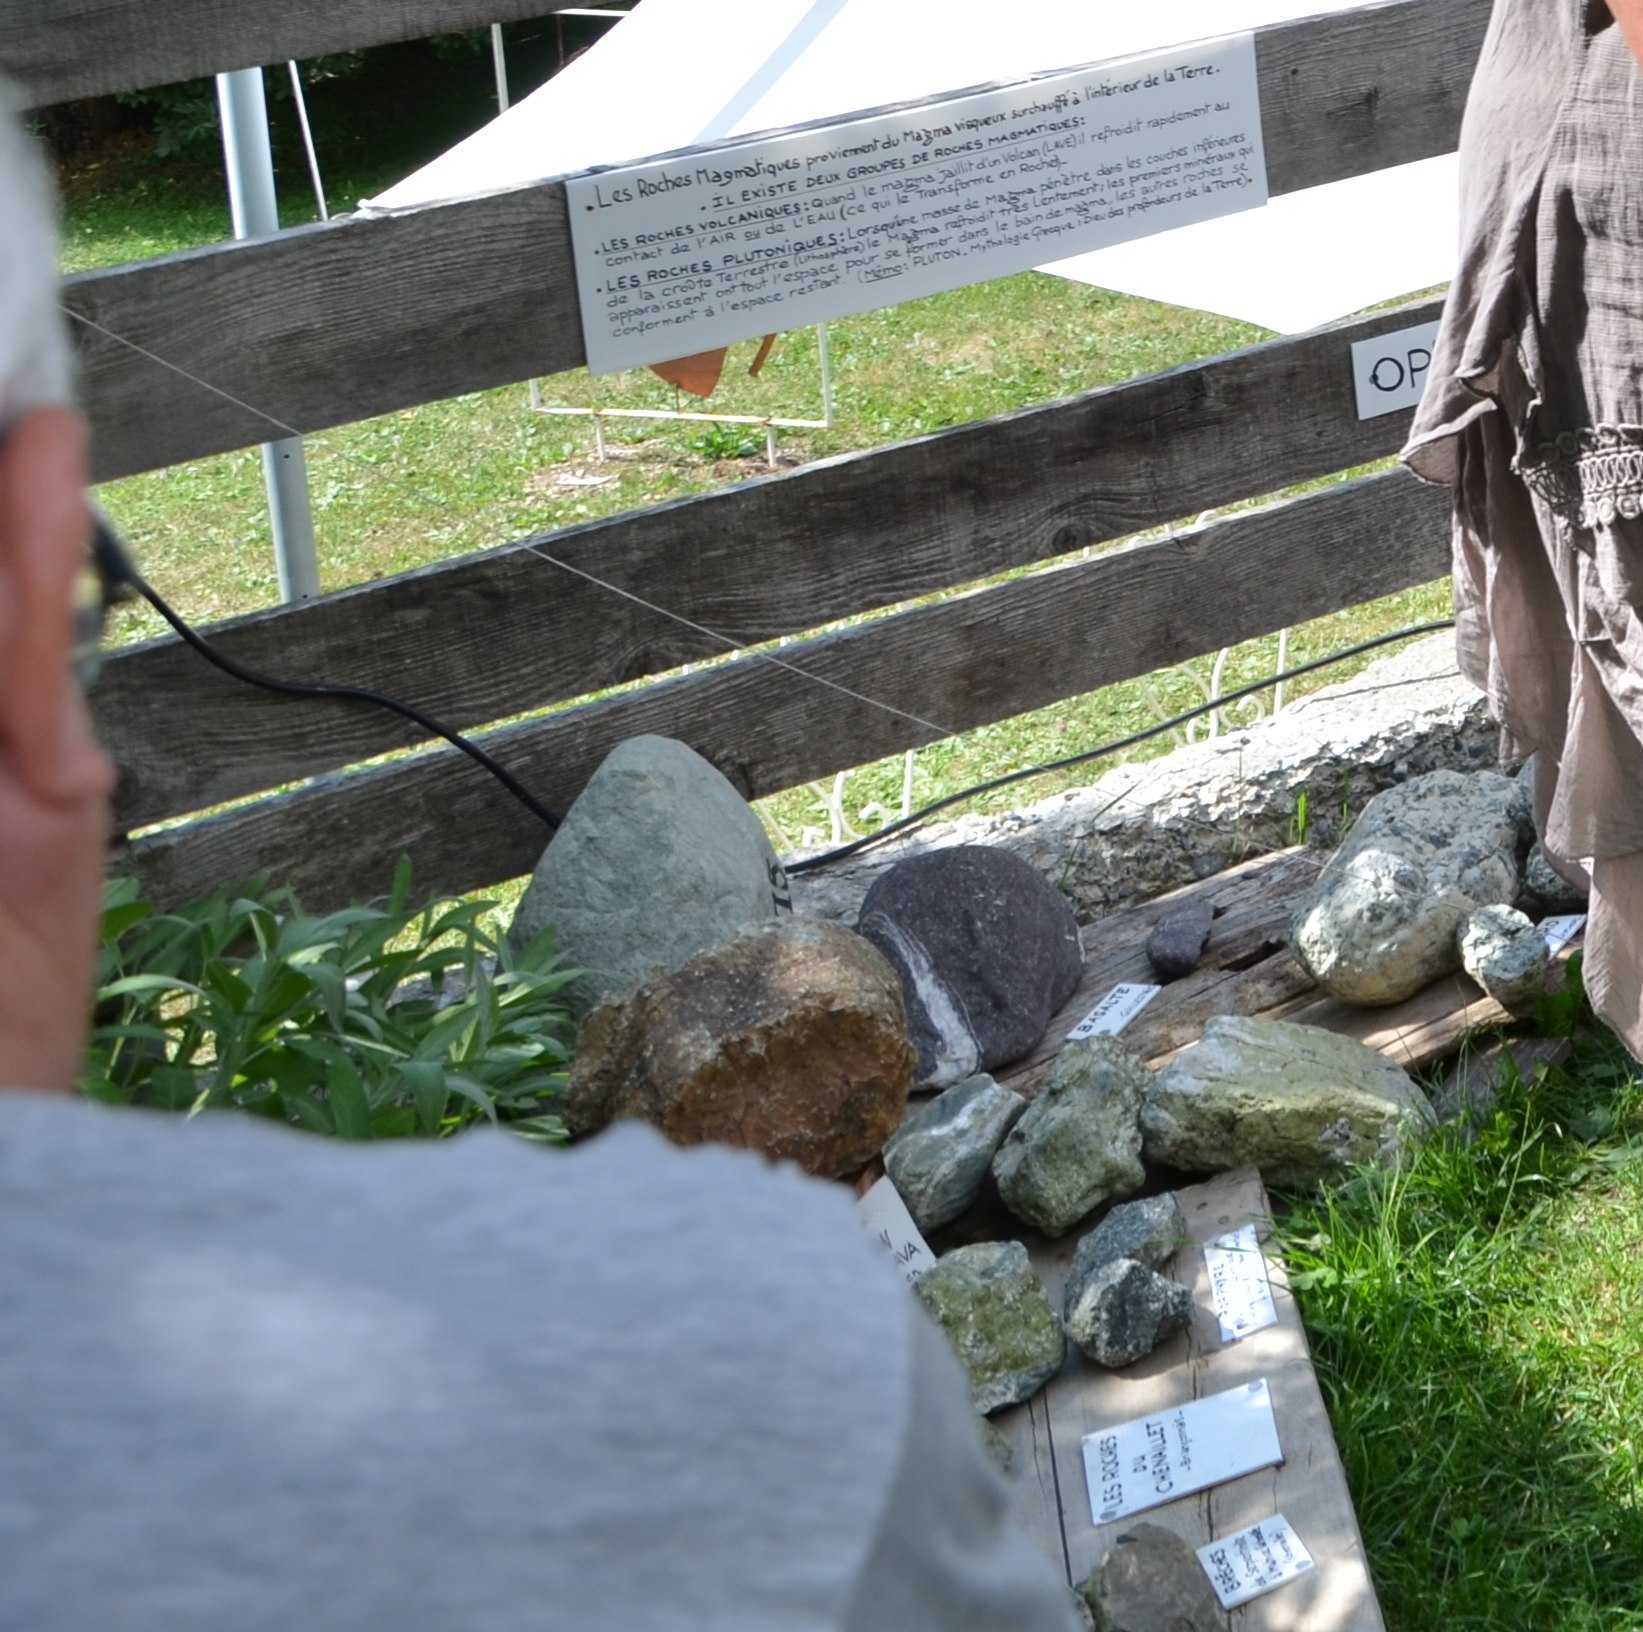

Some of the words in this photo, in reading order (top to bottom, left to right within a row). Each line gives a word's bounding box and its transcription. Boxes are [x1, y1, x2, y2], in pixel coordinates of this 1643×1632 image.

[595, 184, 632, 208] Les
[636, 171, 692, 197] Roches
[695, 157, 800, 186] Magmatiques
[881, 134, 899, 149] du
[902, 125, 952, 146] Magma
[1071, 91, 1080, 105] à
[1085, 78, 1141, 100] l'intérieur
[1143, 73, 1159, 88] de
[1163, 69, 1175, 82] la
[601, 237, 629, 252] LES
[635, 224, 694, 244] ROCHES
[811, 187, 856, 208] Quand
[862, 185, 876, 196] le
[881, 174, 935, 195] magma
[975, 157, 1000, 169] d'un
[1002, 148, 1040, 163] Volcan
[1042, 133, 1076, 156] (LAVE)
[1078, 131, 1085, 144] il
[1090, 120, 1142, 143] refroidit
[1146, 103, 1211, 129] rapidement
[1214, 102, 1229, 111] au
[806, 173, 840, 187] DEUX
[846, 158, 905, 179] GROUPES
[911, 151, 928, 164] DE
[933, 139, 983, 157] ROCHES
[605, 246, 663, 266] contact
[670, 242, 691, 254] de
[743, 229, 760, 239] ou
[765, 222, 785, 234] de
[871, 200, 890, 212] qui
[896, 189, 909, 204] le
[999, 169, 1015, 179] en
[606, 274, 640, 292] LES
[646, 260, 712, 281] ROCHES
[921, 204, 960, 218] masse
[964, 198, 980, 210] de
[985, 187, 1036, 205] Magma
[1039, 171, 1092, 195] pénètre
[1096, 162, 1122, 176] dans
[1126, 156, 1141, 169] les
[1146, 146, 1188, 164] couches
[606, 295, 628, 307] de
[638, 288, 655, 300] la
[661, 278, 712, 296] croûte
[715, 260, 789, 282] Terrestre
[867, 238, 880, 248] le
[887, 226, 939, 243] Magma
[944, 209, 994, 230] refroidit
[997, 202, 1028, 215] très
[1107, 178, 1125, 189] les
[1129, 163, 1181, 187] premiers
[1183, 151, 1235, 169] minéraux
[1238, 145, 1253, 159] qui
[607, 291, 707, 325] apparaissent
[715, 284, 736, 298] ont
[773, 263, 838, 284] l'espace
[845, 254, 879, 273] pour
[884, 249, 901, 259] se
[905, 236, 952, 257] former
[958, 227, 989, 242] dans
[995, 221, 1008, 231] le
[1014, 213, 1043, 227] bain
[1045, 208, 1062, 219] de
[1115, 188, 1135, 200] les
[1140, 178, 1178, 195] autres
[1182, 166, 1223, 183] roches
[1232, 162, 1248, 173] se
[612, 308, 698, 337] conforment
[703, 305, 714, 317] à
[720, 292, 783, 311] l'espace
[1107, 207, 1124, 218] des
[1184, 188, 1198, 198] de
[1202, 185, 1212, 193] la
[1076, 986, 1131, 1033] BASALTE
[1100, 1434, 1122, 1487] ROCHES
[1102, 1486, 1124, 1509] LES
